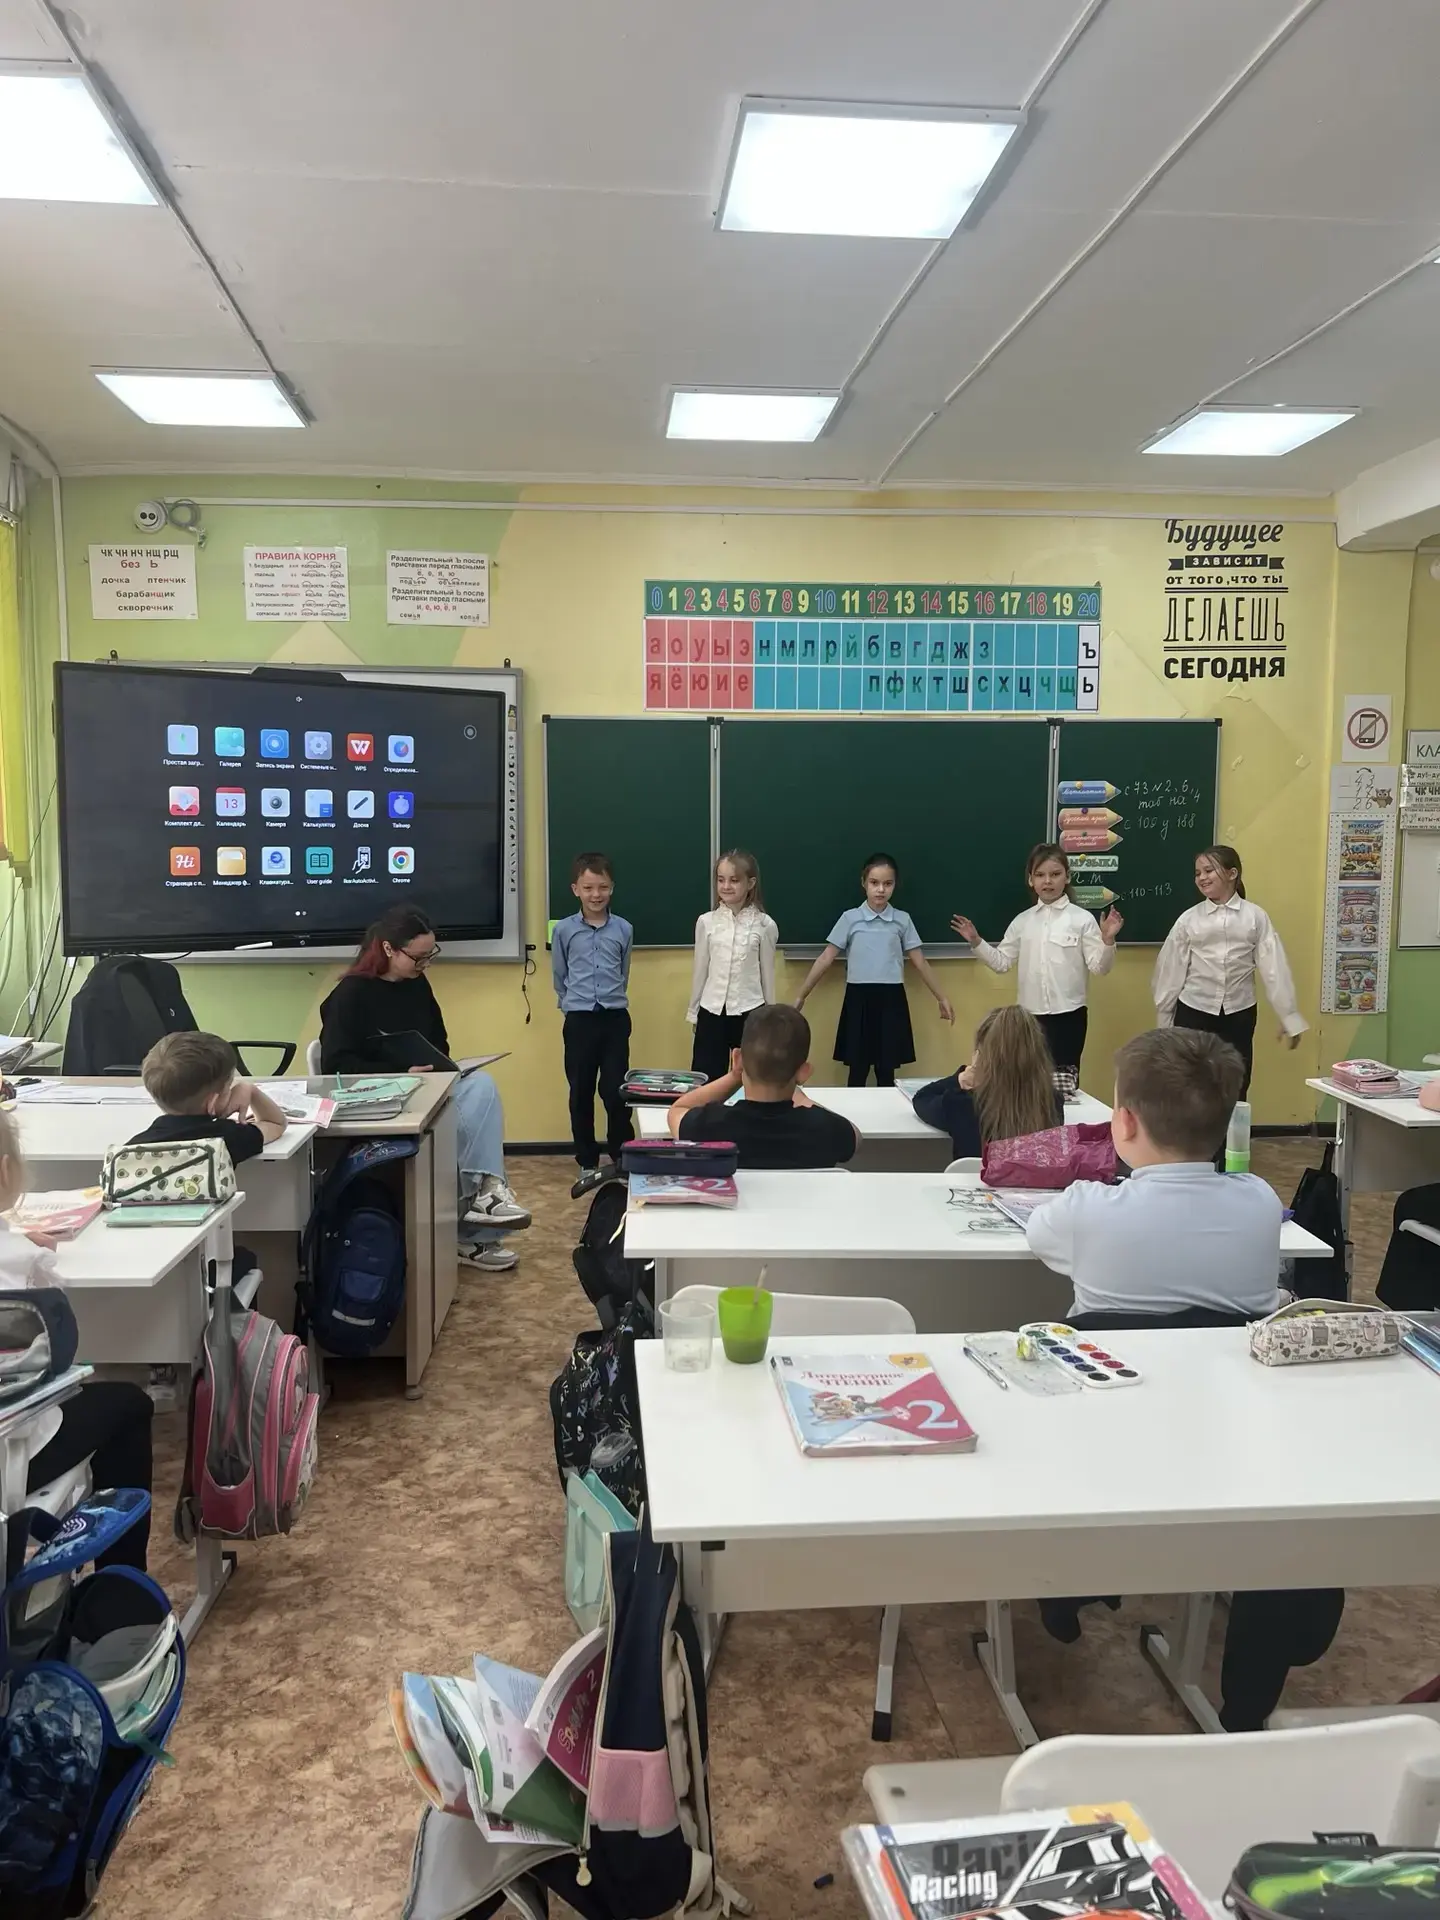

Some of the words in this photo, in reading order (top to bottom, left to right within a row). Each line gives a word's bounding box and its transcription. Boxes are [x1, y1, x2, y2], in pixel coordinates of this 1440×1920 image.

[1164, 518, 1284, 551] Будущее
[120, 560, 140, 568] без
[1193, 557, 1263, 566] ЗАВИСИТ
[1263, 575, 1283, 583] ты
[116, 590, 175, 599] барабанщик
[651, 586, 663, 611] 0
[668, 587, 678, 611] 1
[684, 587, 696, 611] 2
[701, 588, 712, 612] 3
[717, 588, 728, 612] 4
[733, 588, 745, 612] 5
[750, 589, 761, 612] 6
[766, 589, 777, 612] 7
[782, 589, 793, 613] 8
[798, 589, 810, 613] 9
[815, 589, 836, 613] 10
[842, 590, 860, 613] 11
[867, 590, 889, 614] 12
[895, 590, 915, 614] 13
[921, 590, 943, 614] 14
[948, 591, 969, 614] 15
[974, 591, 995, 615] 16
[1000, 591, 1022, 615] 17
[1026, 592, 1047, 615] 18
[1052, 592, 1074, 616] 19
[1078, 593, 1099, 616] 20
[1163, 597, 1285, 641] ДЕЛАЕШЬ
[671, 638, 683, 655] о
[694, 638, 706, 662] у
[714, 639, 730, 656] ы
[740, 639, 750, 657] э
[759, 639, 770, 657] н
[781, 639, 795, 657] м
[802, 640, 815, 657] л
[825, 639, 837, 663] р
[846, 634, 857, 658] й
[867, 635, 880, 658] б
[890, 641, 901, 658] в
[913, 641, 921, 658] г
[931, 641, 944, 663] д
[953, 642, 969, 658] ж
[1164, 657, 1285, 682] СЕГОДНЯ
[886, 670, 904, 698] ф
[224, 799, 238, 809] 13
[907, 1400, 959, 1429] 2
[910, 1869, 998, 1904] Racing
